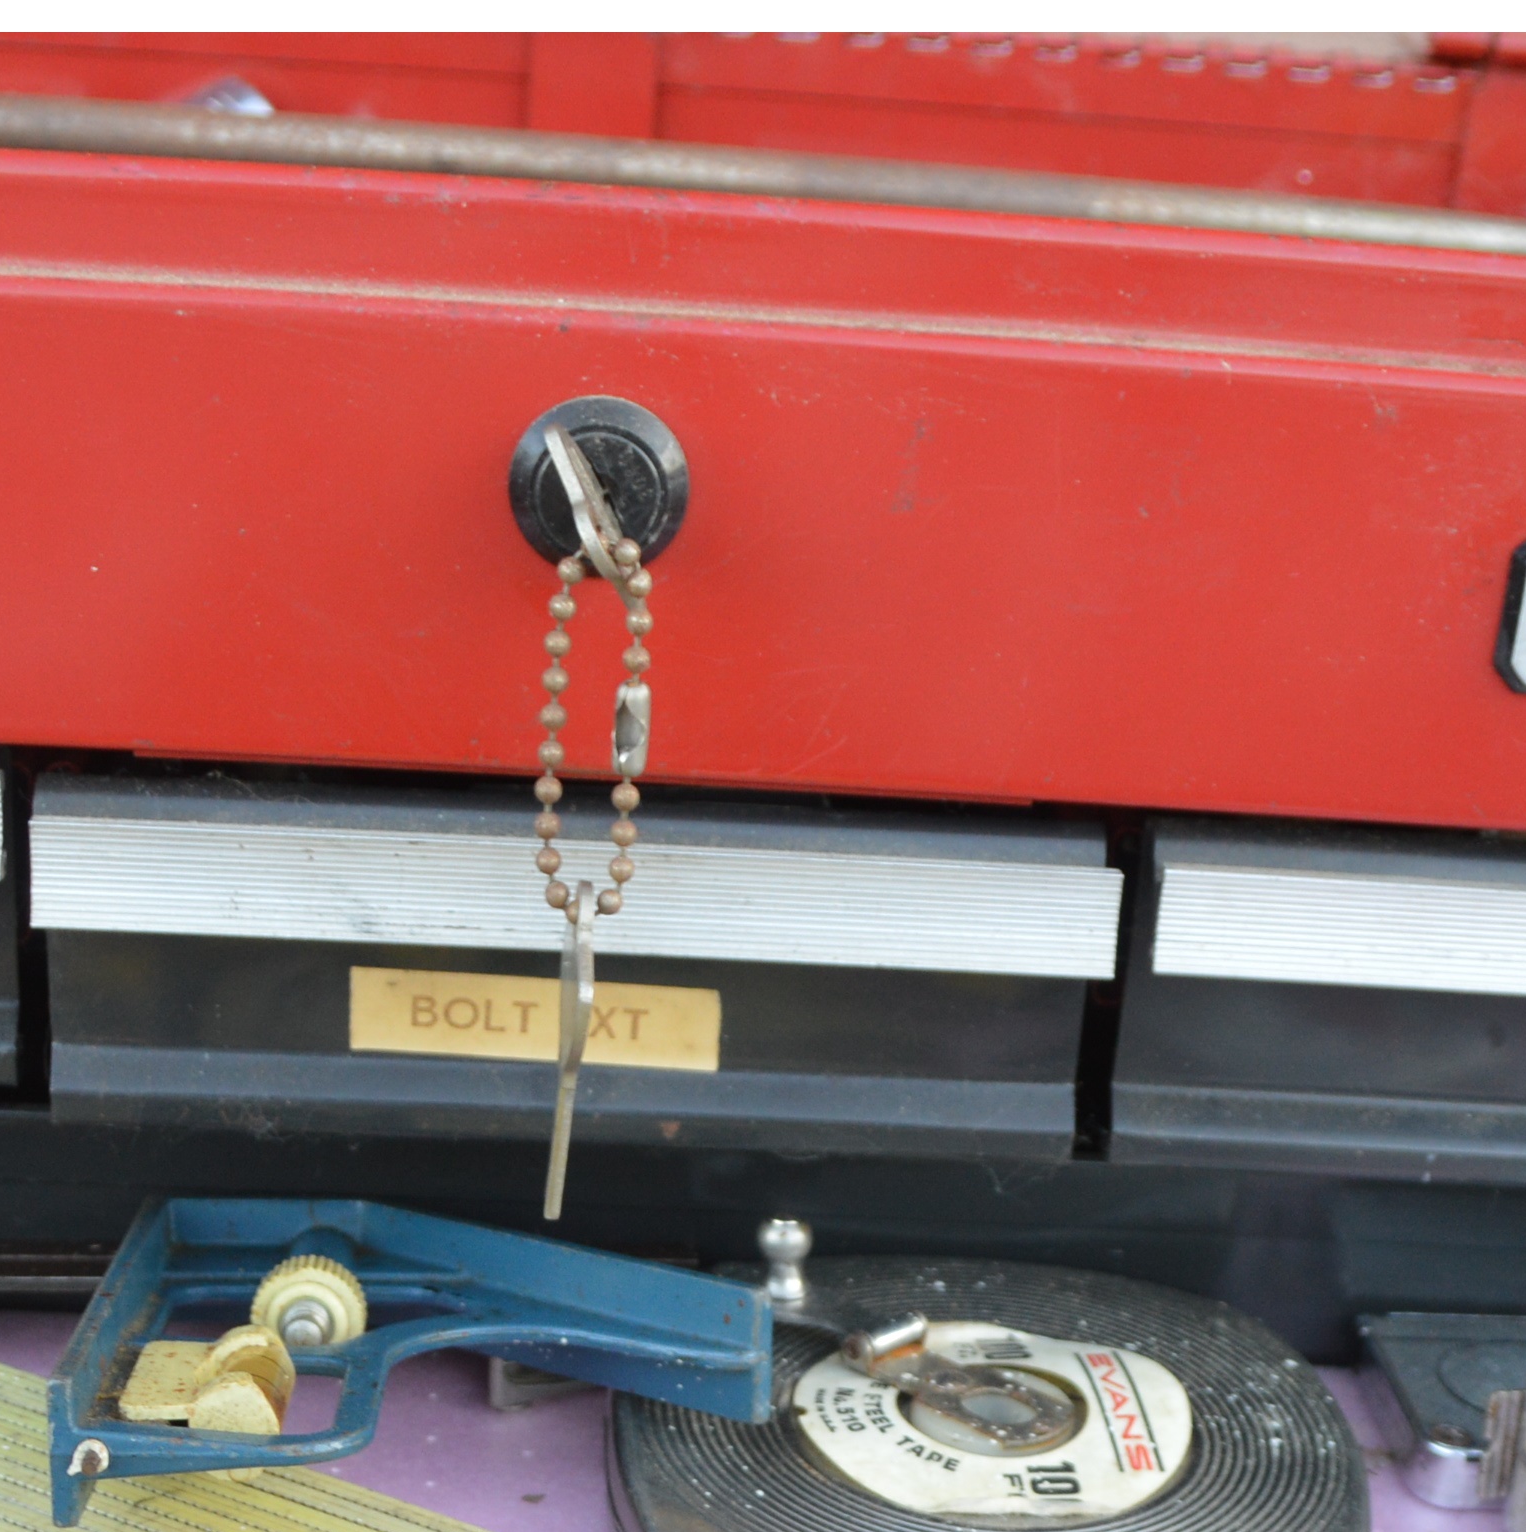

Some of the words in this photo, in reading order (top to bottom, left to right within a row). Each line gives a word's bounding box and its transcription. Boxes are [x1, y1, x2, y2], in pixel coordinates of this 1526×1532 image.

[410, 994, 539, 1035] BOLT
[589, 1006, 650, 1040] XT
[1086, 1352, 1154, 1473] EVANS
[896, 1434, 961, 1472] TAPE
[1027, 1459, 1083, 1502] 10
